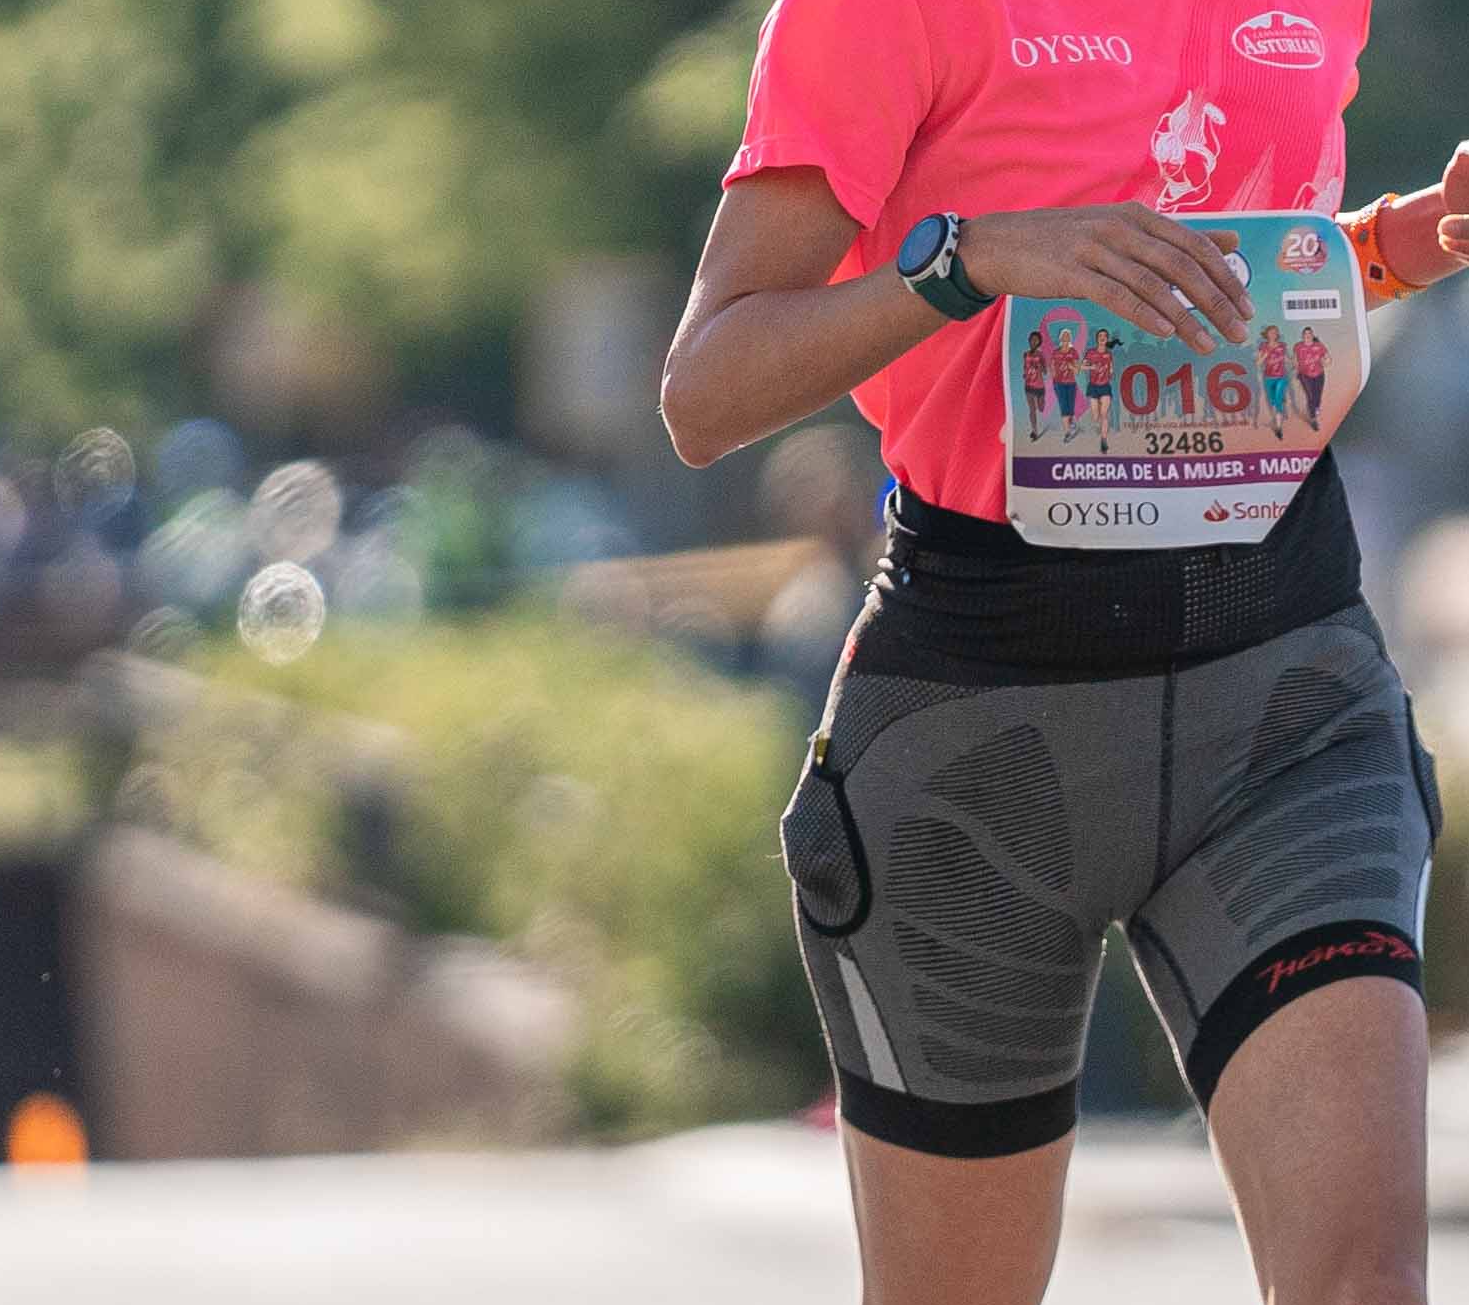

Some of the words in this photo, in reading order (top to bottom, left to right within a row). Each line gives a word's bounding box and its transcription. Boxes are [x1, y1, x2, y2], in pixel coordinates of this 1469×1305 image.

[1011, 35, 1132, 67] OYSHO
[1285, 233, 1319, 256] 20
[1120, 362, 1252, 415] 016
[1145, 431, 1224, 455] 32486
[1051, 462, 1128, 481] CARRERA
[1132, 462, 1153, 480] DE
[1157, 463, 1179, 481] LA
[1183, 461, 1244, 480] MUJER
[1048, 501, 1159, 526] OYSHO
